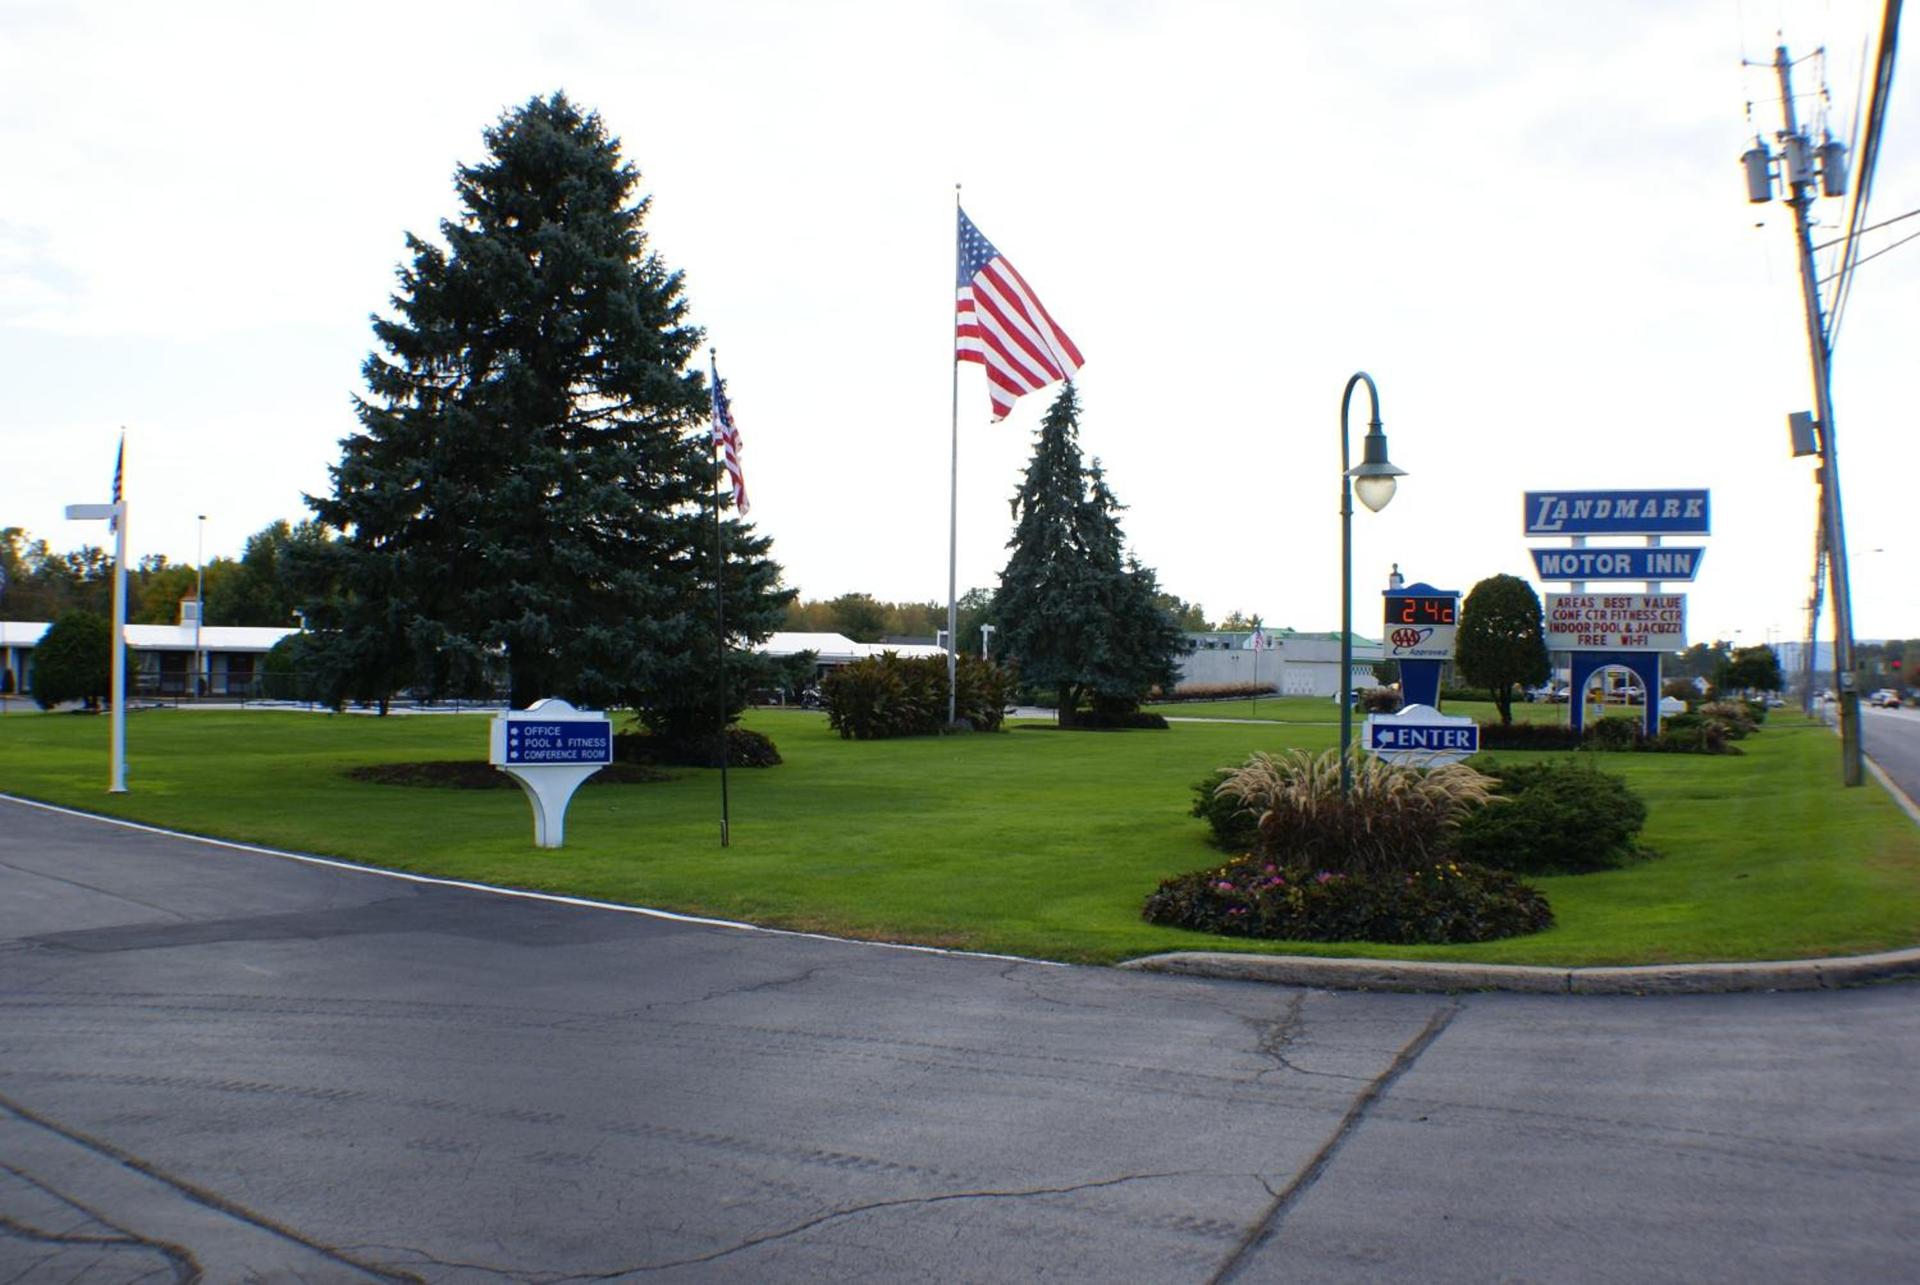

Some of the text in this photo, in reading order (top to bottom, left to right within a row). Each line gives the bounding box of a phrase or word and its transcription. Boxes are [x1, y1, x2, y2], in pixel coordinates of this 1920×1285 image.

[1529, 496, 1703, 531] LANDMARK
[1541, 553, 1690, 574] MOTOR INN
[1556, 597, 1681, 608] AREAS BEST VALUE
[1552, 609, 1682, 620] CONF CTR FITNESS CTR
[1549, 622, 1682, 633] INDOOR POOL & JACUZZI
[1393, 628, 1419, 647] AAA
[1578, 635, 1648, 645] FREE WI-FI
[524, 726, 561, 736] OFFICE
[524, 738, 607, 748] POOL & FITNESS
[1398, 729, 1470, 747] ENTER
[523, 749, 606, 760] CONFERENCE ROOM
